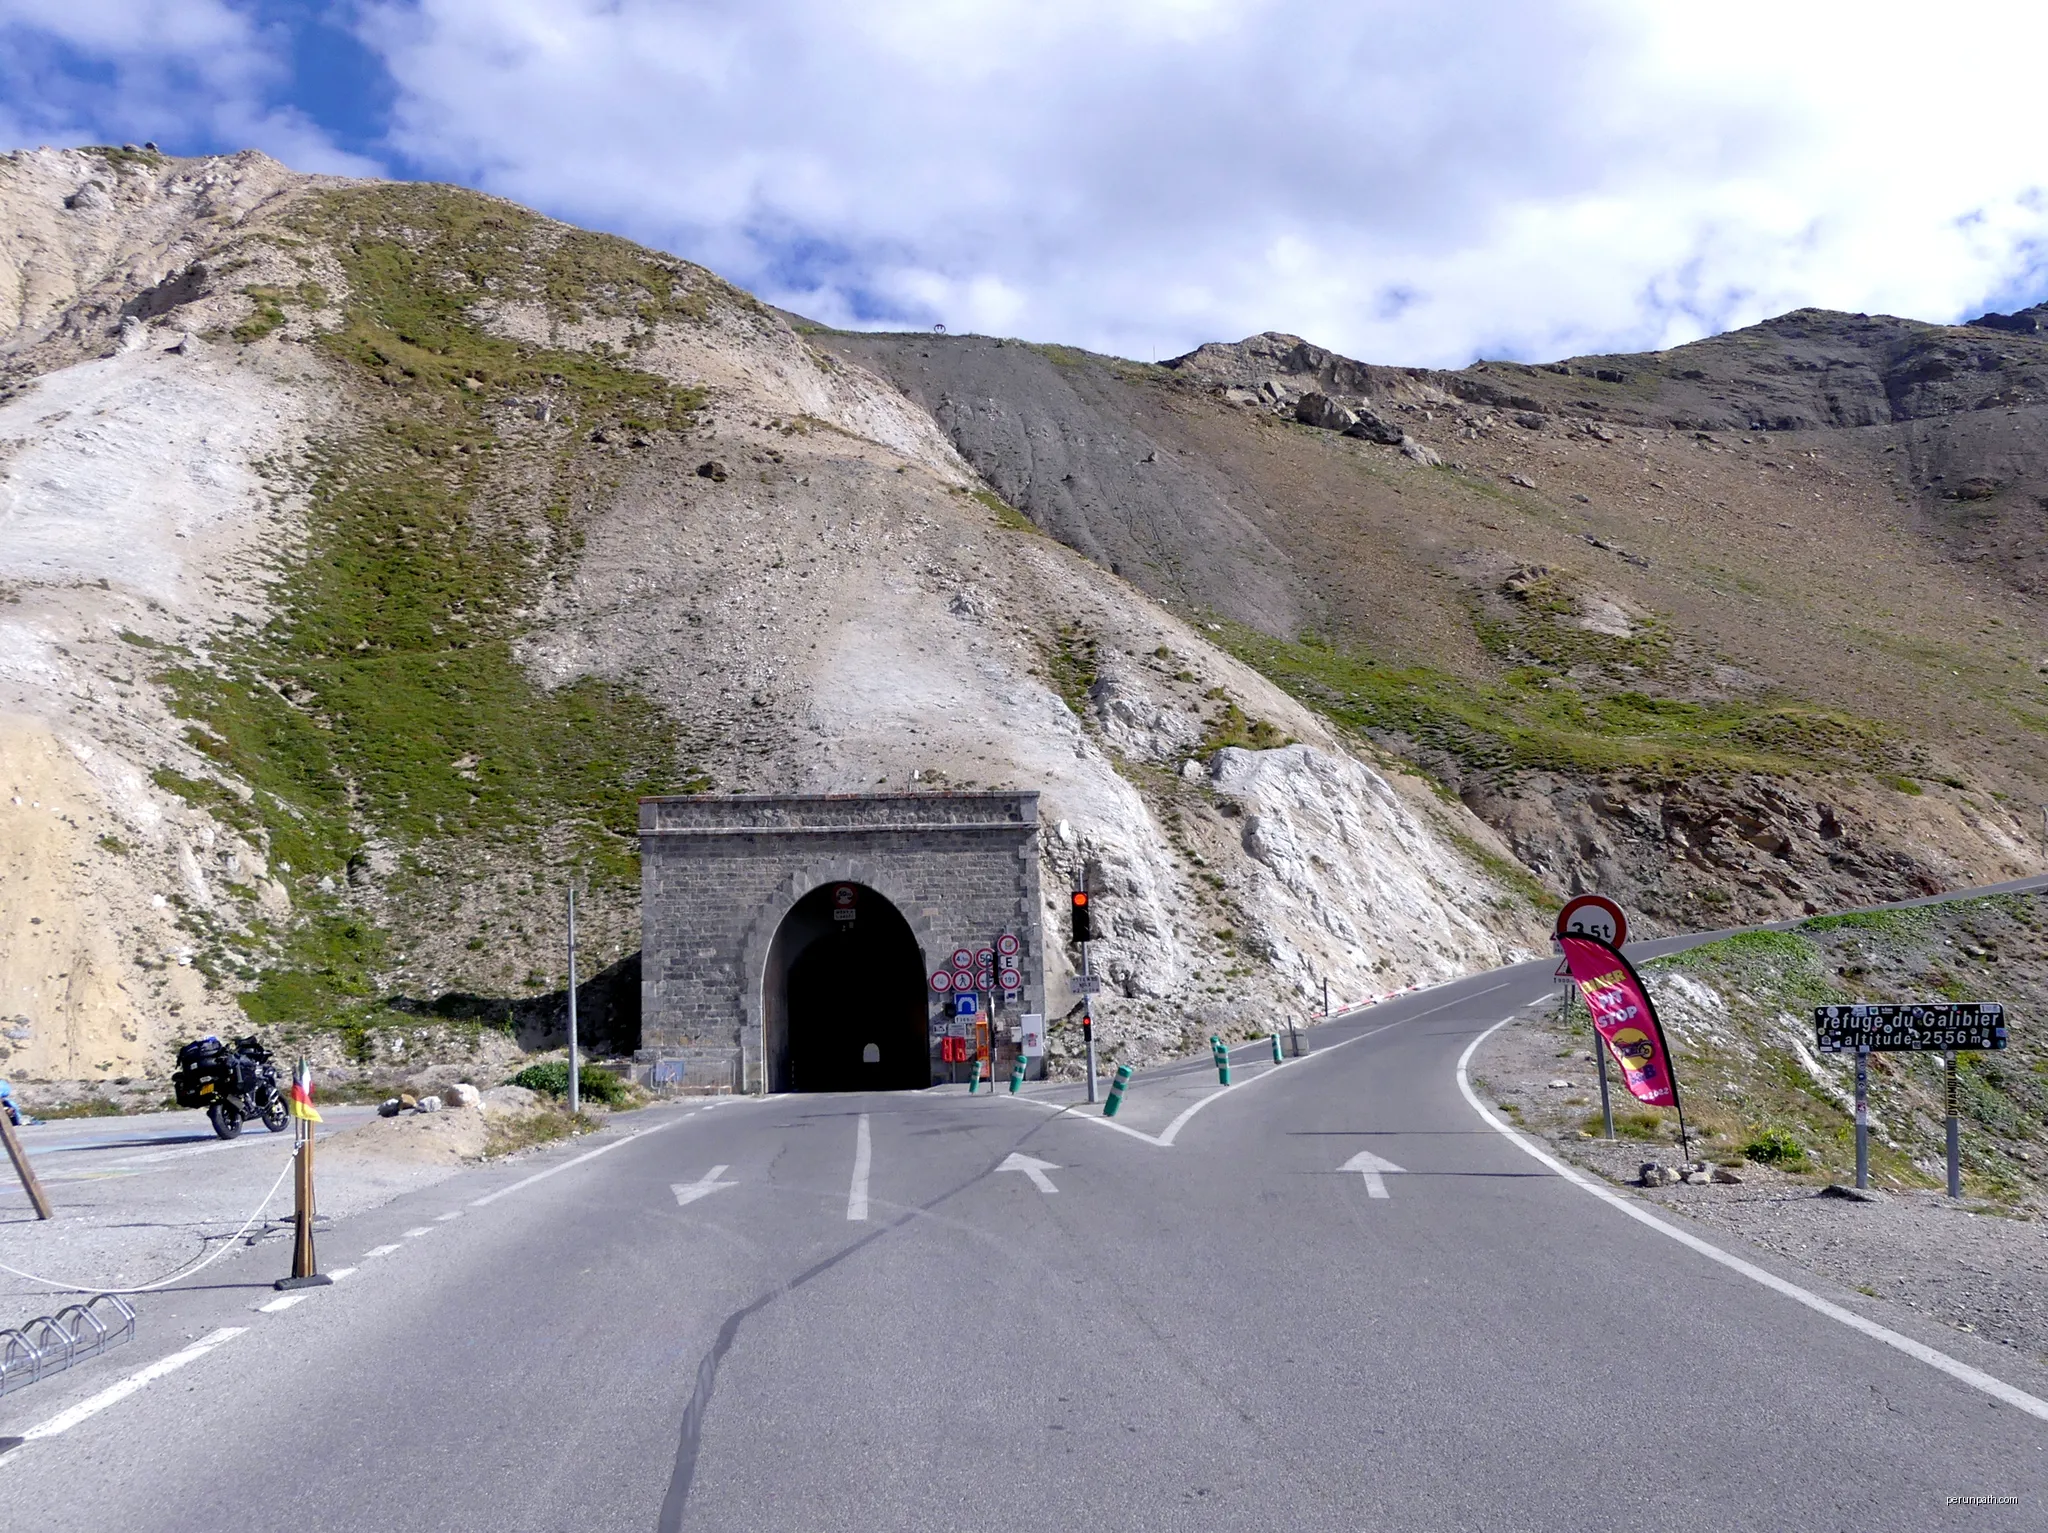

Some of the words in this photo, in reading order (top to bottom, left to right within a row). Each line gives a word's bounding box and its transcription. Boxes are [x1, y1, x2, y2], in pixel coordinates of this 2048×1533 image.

[1005, 956, 1013, 967] E
[1598, 989, 1624, 1008] PIT
[1597, 1006, 1638, 1028] STOP
[1823, 1013, 1883, 1032] refuge
[1892, 1012, 1913, 1028] du
[1922, 1010, 1999, 1027] Galibier
[1844, 1032, 1912, 1045] altitude
[1922, 1031, 1966, 1044] 2556
[1970, 1035, 1981, 1043] m
[1947, 1060, 1958, 1116] DYNAMOLAND
